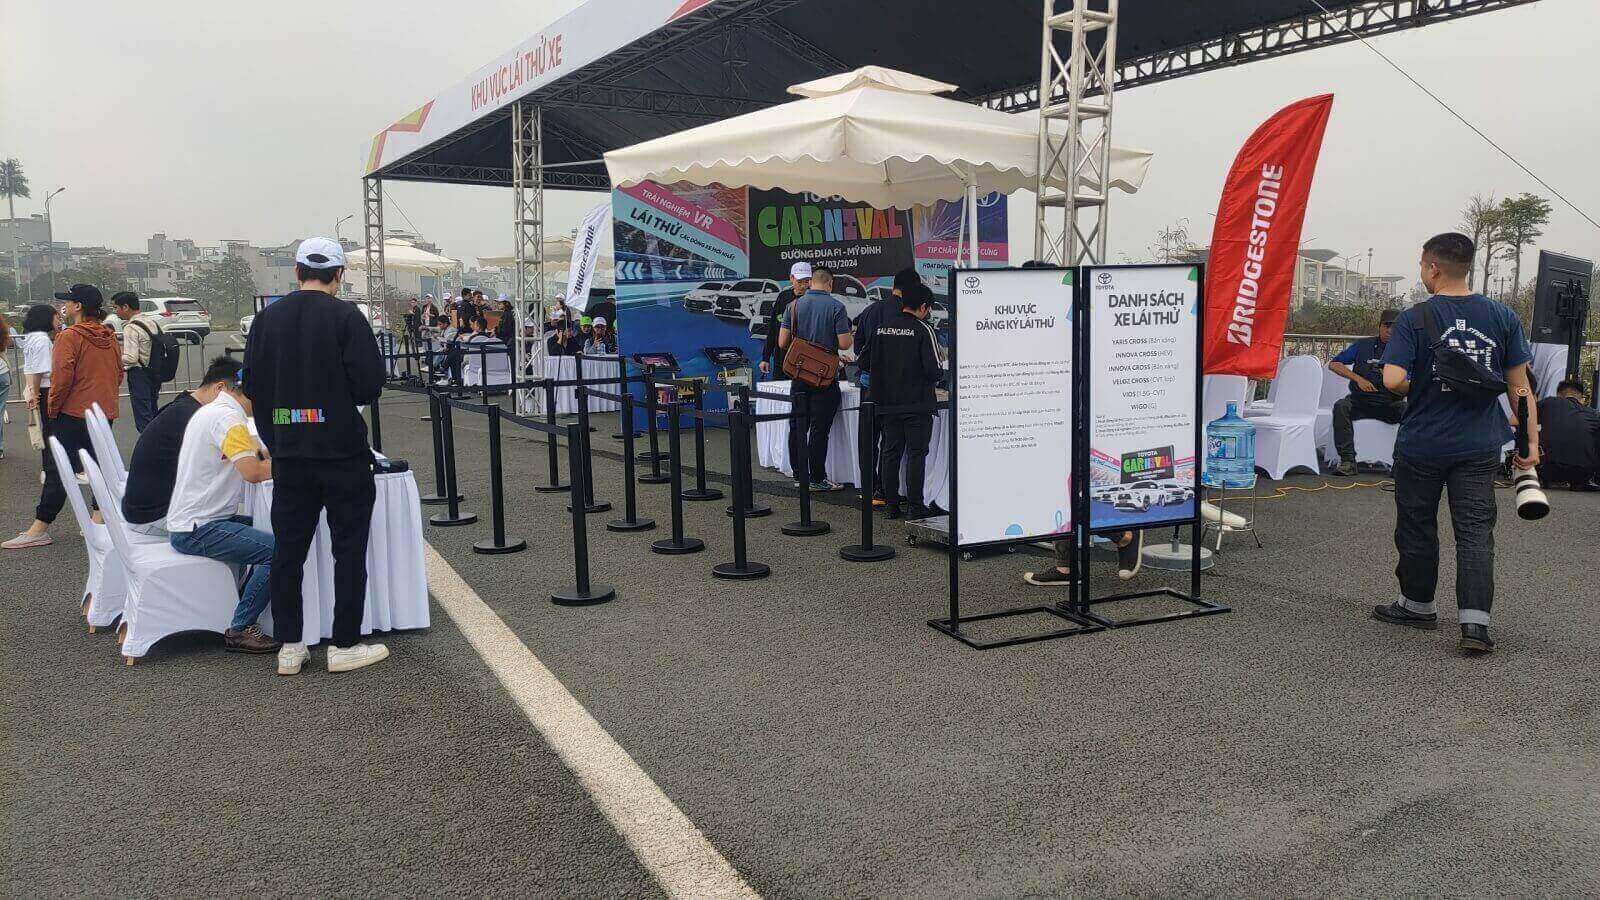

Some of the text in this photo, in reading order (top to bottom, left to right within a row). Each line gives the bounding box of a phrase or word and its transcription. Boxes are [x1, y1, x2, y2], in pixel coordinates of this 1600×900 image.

[472, 78, 488, 111] KHU
[489, 65, 507, 104] VỰC
[509, 51, 523, 91] LÁI
[548, 34, 562, 70] XE
[630, 207, 651, 225] LÁI
[694, 210, 714, 229] VR
[757, 205, 903, 247] CARNIVAL
[573, 224, 595, 295] BRIDGESTONE
[815, 248, 833, 258] ĐUA
[1227, 162, 1283, 348] BRIDGESTONE
[1109, 290, 1184, 308] DANH SÁCH
[994, 303, 1037, 317] KHU VỰC
[1114, 308, 1180, 326] XE LÁI THỬ
[976, 316, 1056, 331] ĐĂNG KÝ LÁI THỬ
